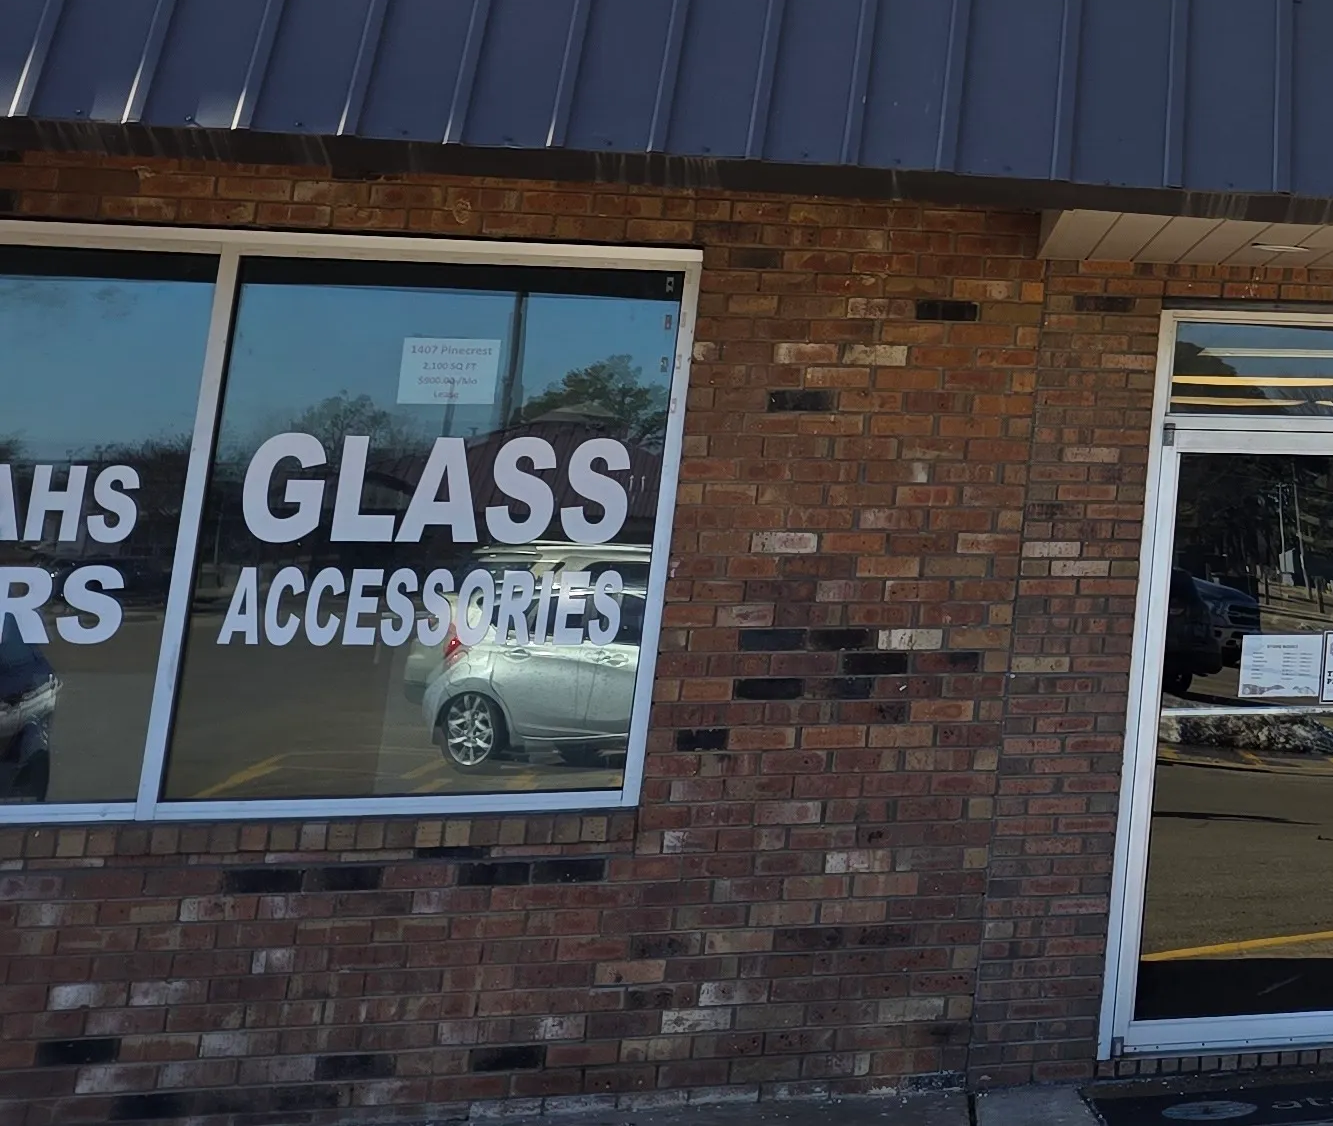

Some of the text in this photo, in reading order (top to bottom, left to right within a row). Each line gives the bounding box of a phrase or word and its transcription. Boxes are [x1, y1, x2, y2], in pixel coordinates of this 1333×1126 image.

[411, 345, 492, 355] 1407 Pinecrest
[450, 362, 463, 371] SQ
[466, 362, 478, 371] FT
[242, 432, 631, 545] GLASS
[217, 567, 622, 646] ACCESSORIES
